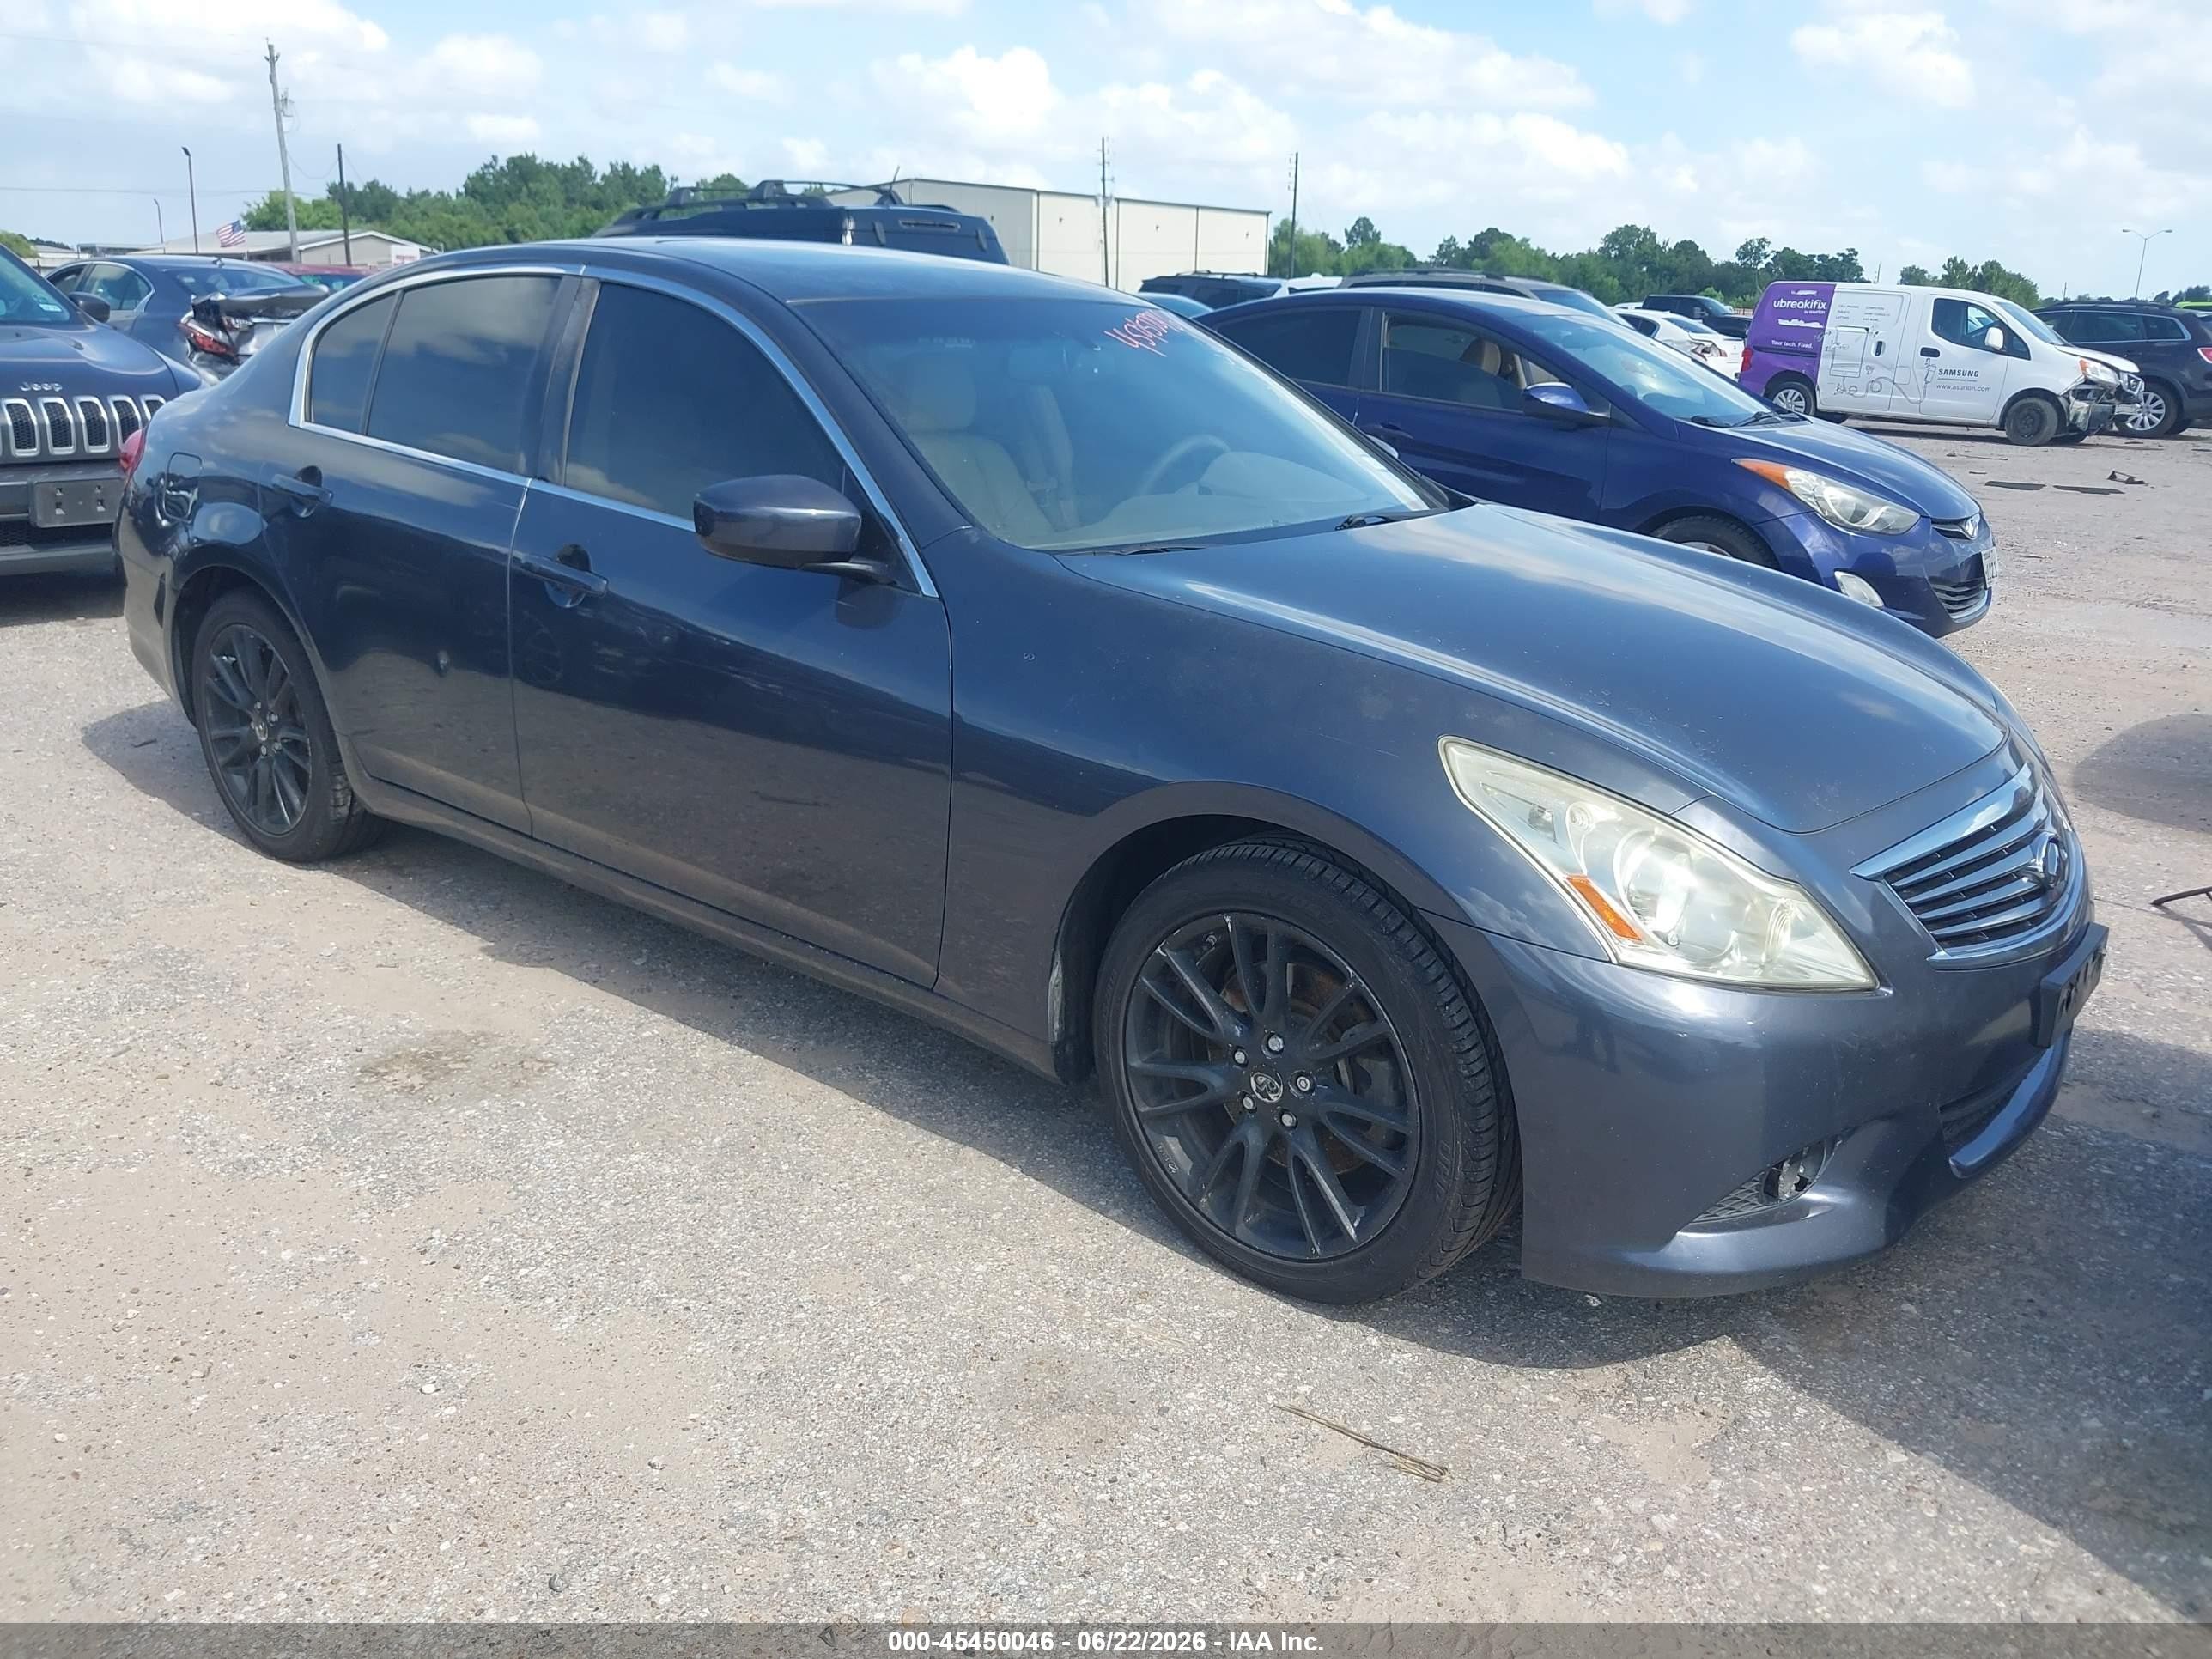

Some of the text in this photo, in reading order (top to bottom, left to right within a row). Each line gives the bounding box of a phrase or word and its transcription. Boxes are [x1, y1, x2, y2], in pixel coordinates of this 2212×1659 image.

[1773, 298, 1826, 309] ubreakifix
[1938, 368, 1979, 377] SAMSUNG
[19, 381, 63, 392] Jeep
